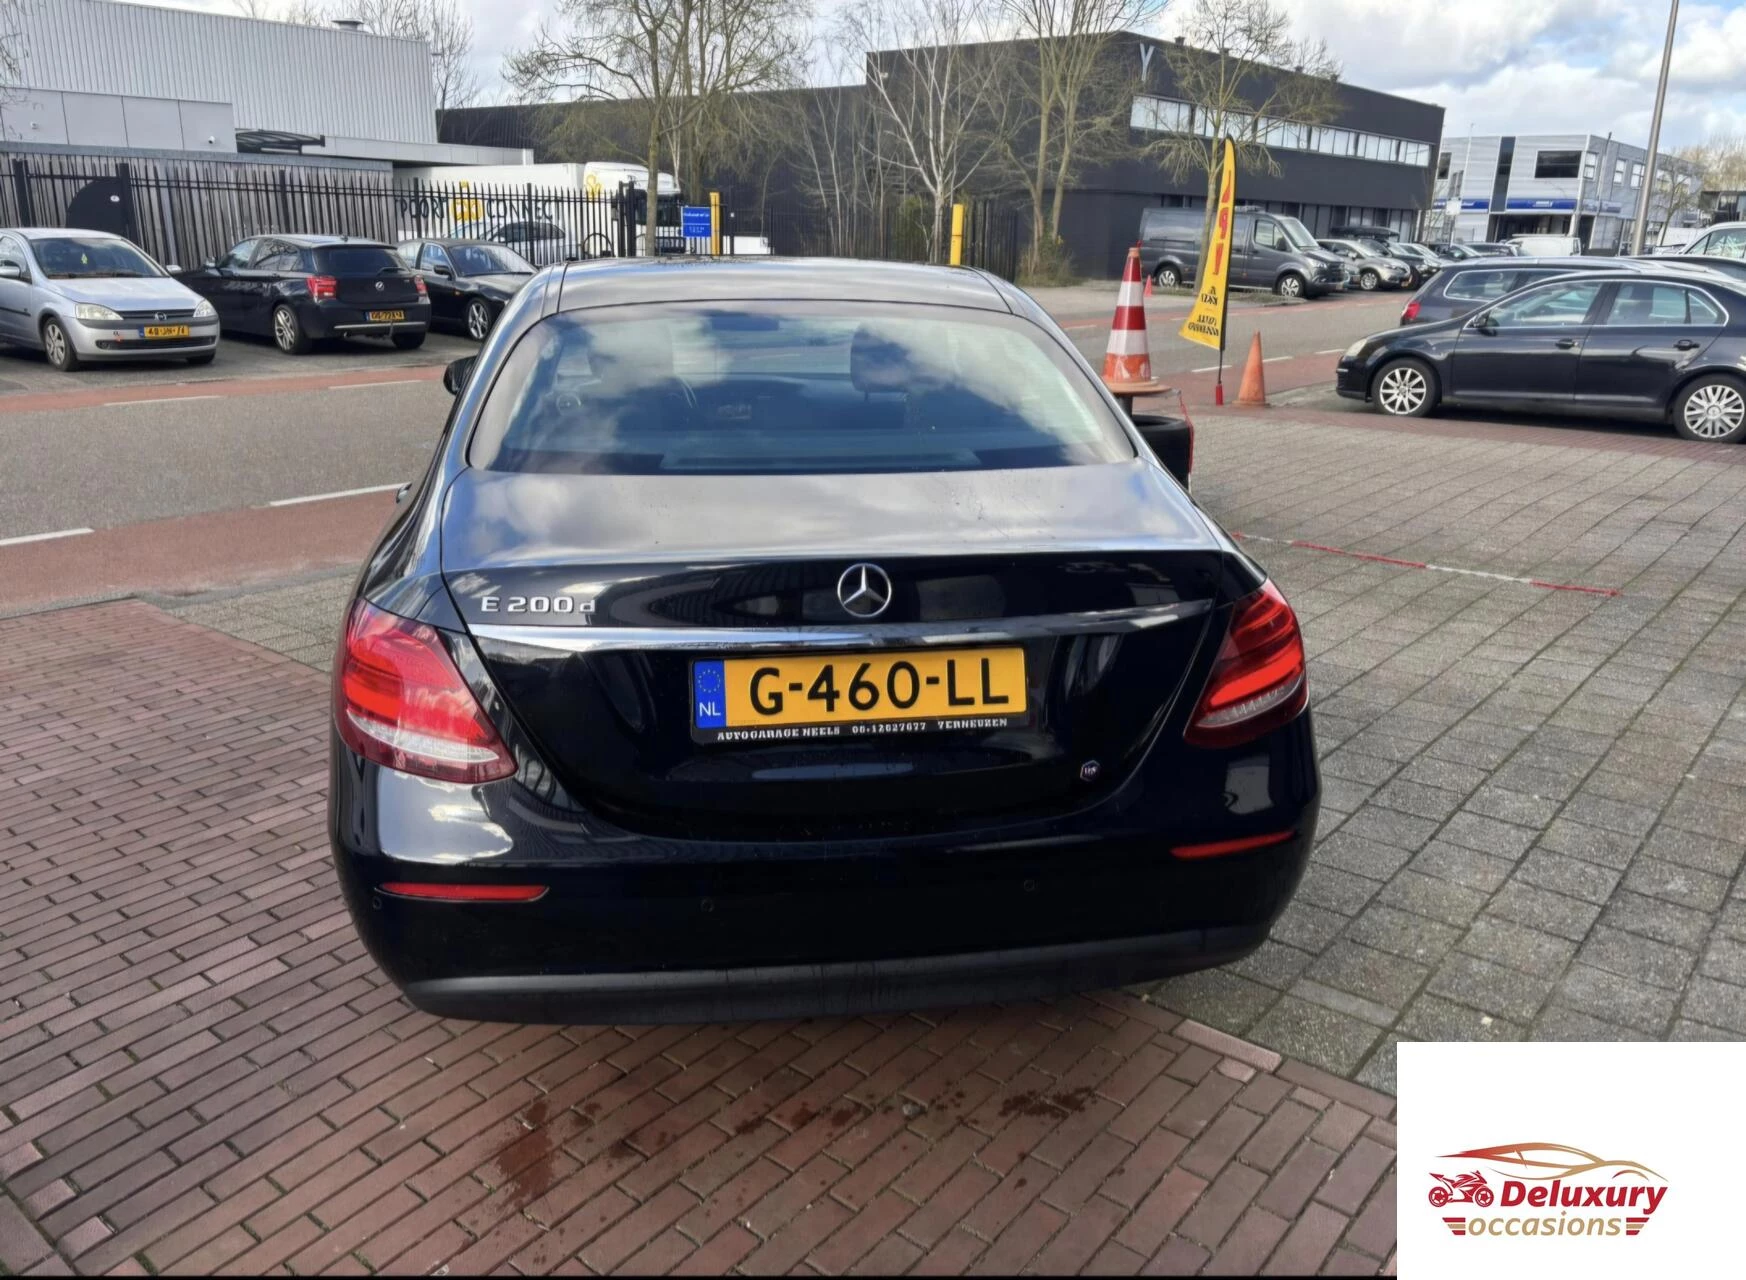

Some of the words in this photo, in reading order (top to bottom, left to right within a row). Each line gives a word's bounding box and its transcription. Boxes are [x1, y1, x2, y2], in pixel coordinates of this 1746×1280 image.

[481, 596, 501, 612] E
[749, 657, 1010, 716] G-460-LL
[699, 701, 721, 718] NL
